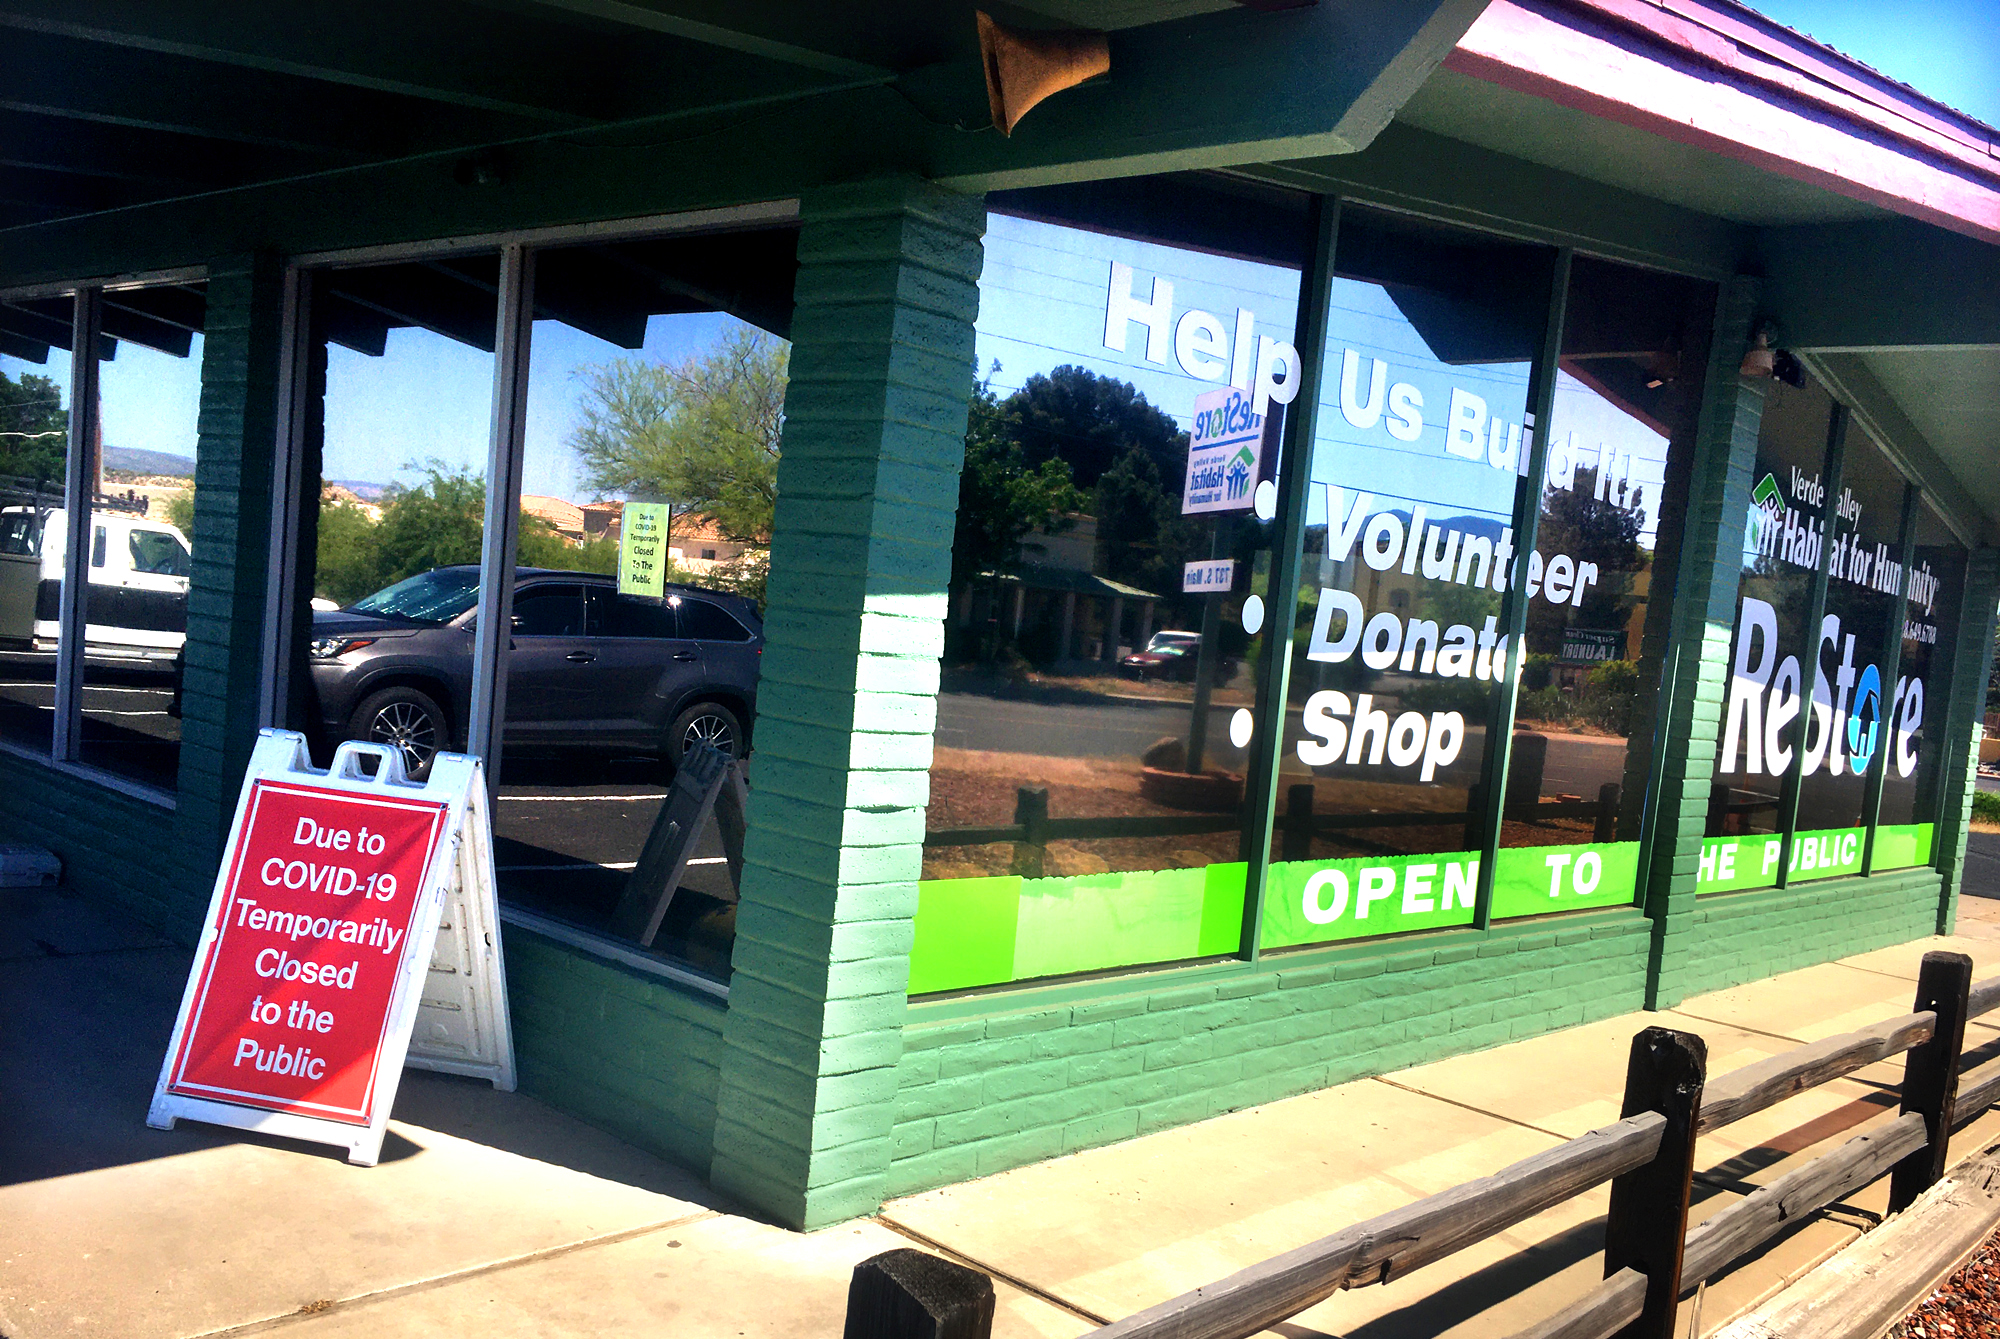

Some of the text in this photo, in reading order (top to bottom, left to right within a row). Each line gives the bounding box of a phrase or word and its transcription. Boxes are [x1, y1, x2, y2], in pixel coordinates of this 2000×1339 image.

[1103, 260, 1639, 510] Help Us Buid It!
[639, 513, 648, 521] Due
[1791, 465, 1862, 531] Verde alley
[630, 533, 660, 544] Temporarily
[635, 523, 657, 532] COVID-19
[1326, 484, 1598, 607] Volunteer
[1780, 507, 1847, 579] Habiat
[1848, 533, 1873, 586] for
[632, 559, 653, 570] To The
[633, 545, 654, 556] Closed
[632, 573, 651, 585] Public
[1306, 587, 1527, 684] Donate
[1720, 596, 1924, 779] ReStore
[1297, 690, 1465, 782] Shop
[293, 816, 386, 856] Due to
[260, 857, 398, 902] COVID-19
[1301, 860, 1479, 925] OPEN
[1545, 852, 1601, 897] TO
[1697, 843, 1738, 882] HE
[236, 899, 404, 955] Temporarily
[255, 948, 358, 990] Closed
[250, 995, 335, 1034] to the
[233, 1038, 327, 1081] Public
